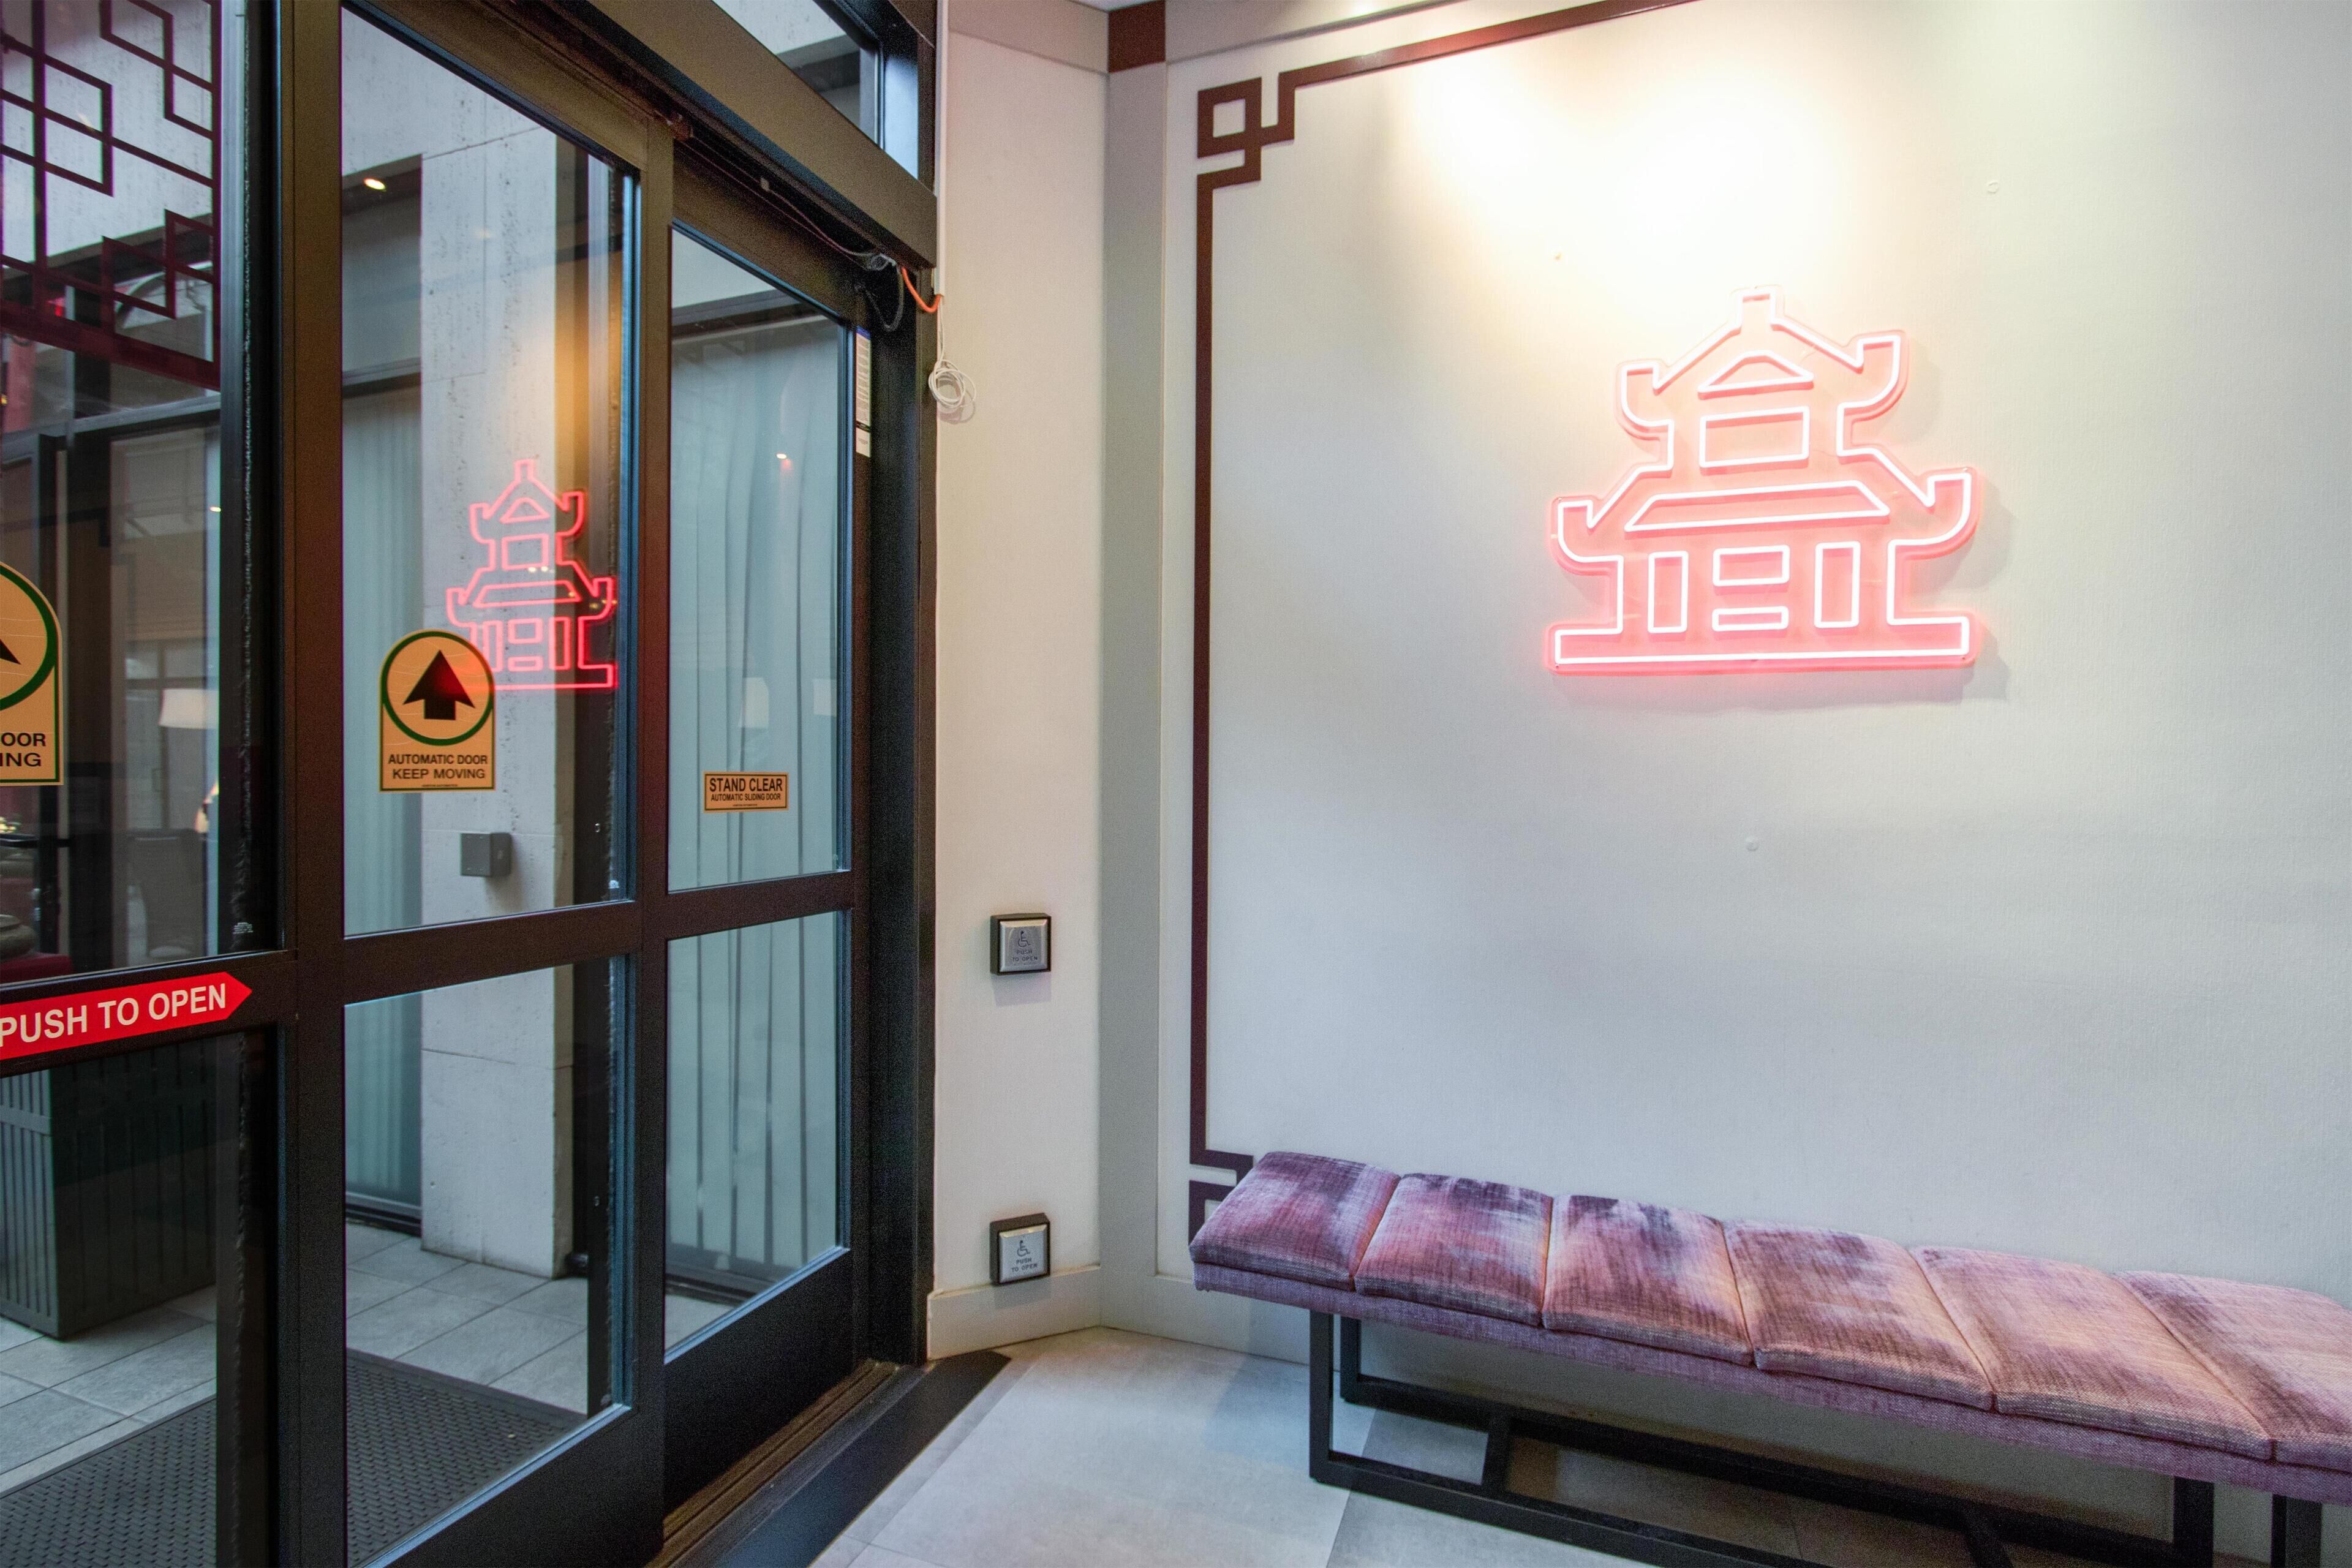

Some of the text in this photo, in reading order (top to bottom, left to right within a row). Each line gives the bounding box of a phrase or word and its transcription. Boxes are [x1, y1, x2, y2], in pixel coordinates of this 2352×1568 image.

[388, 754, 488, 765] AUTOMATIC DOOR
[393, 769, 485, 779] KEEP MOVING
[709, 778, 783, 792] STAND CLEAR
[0, 983, 225, 1047] PUSH TO OPEN
